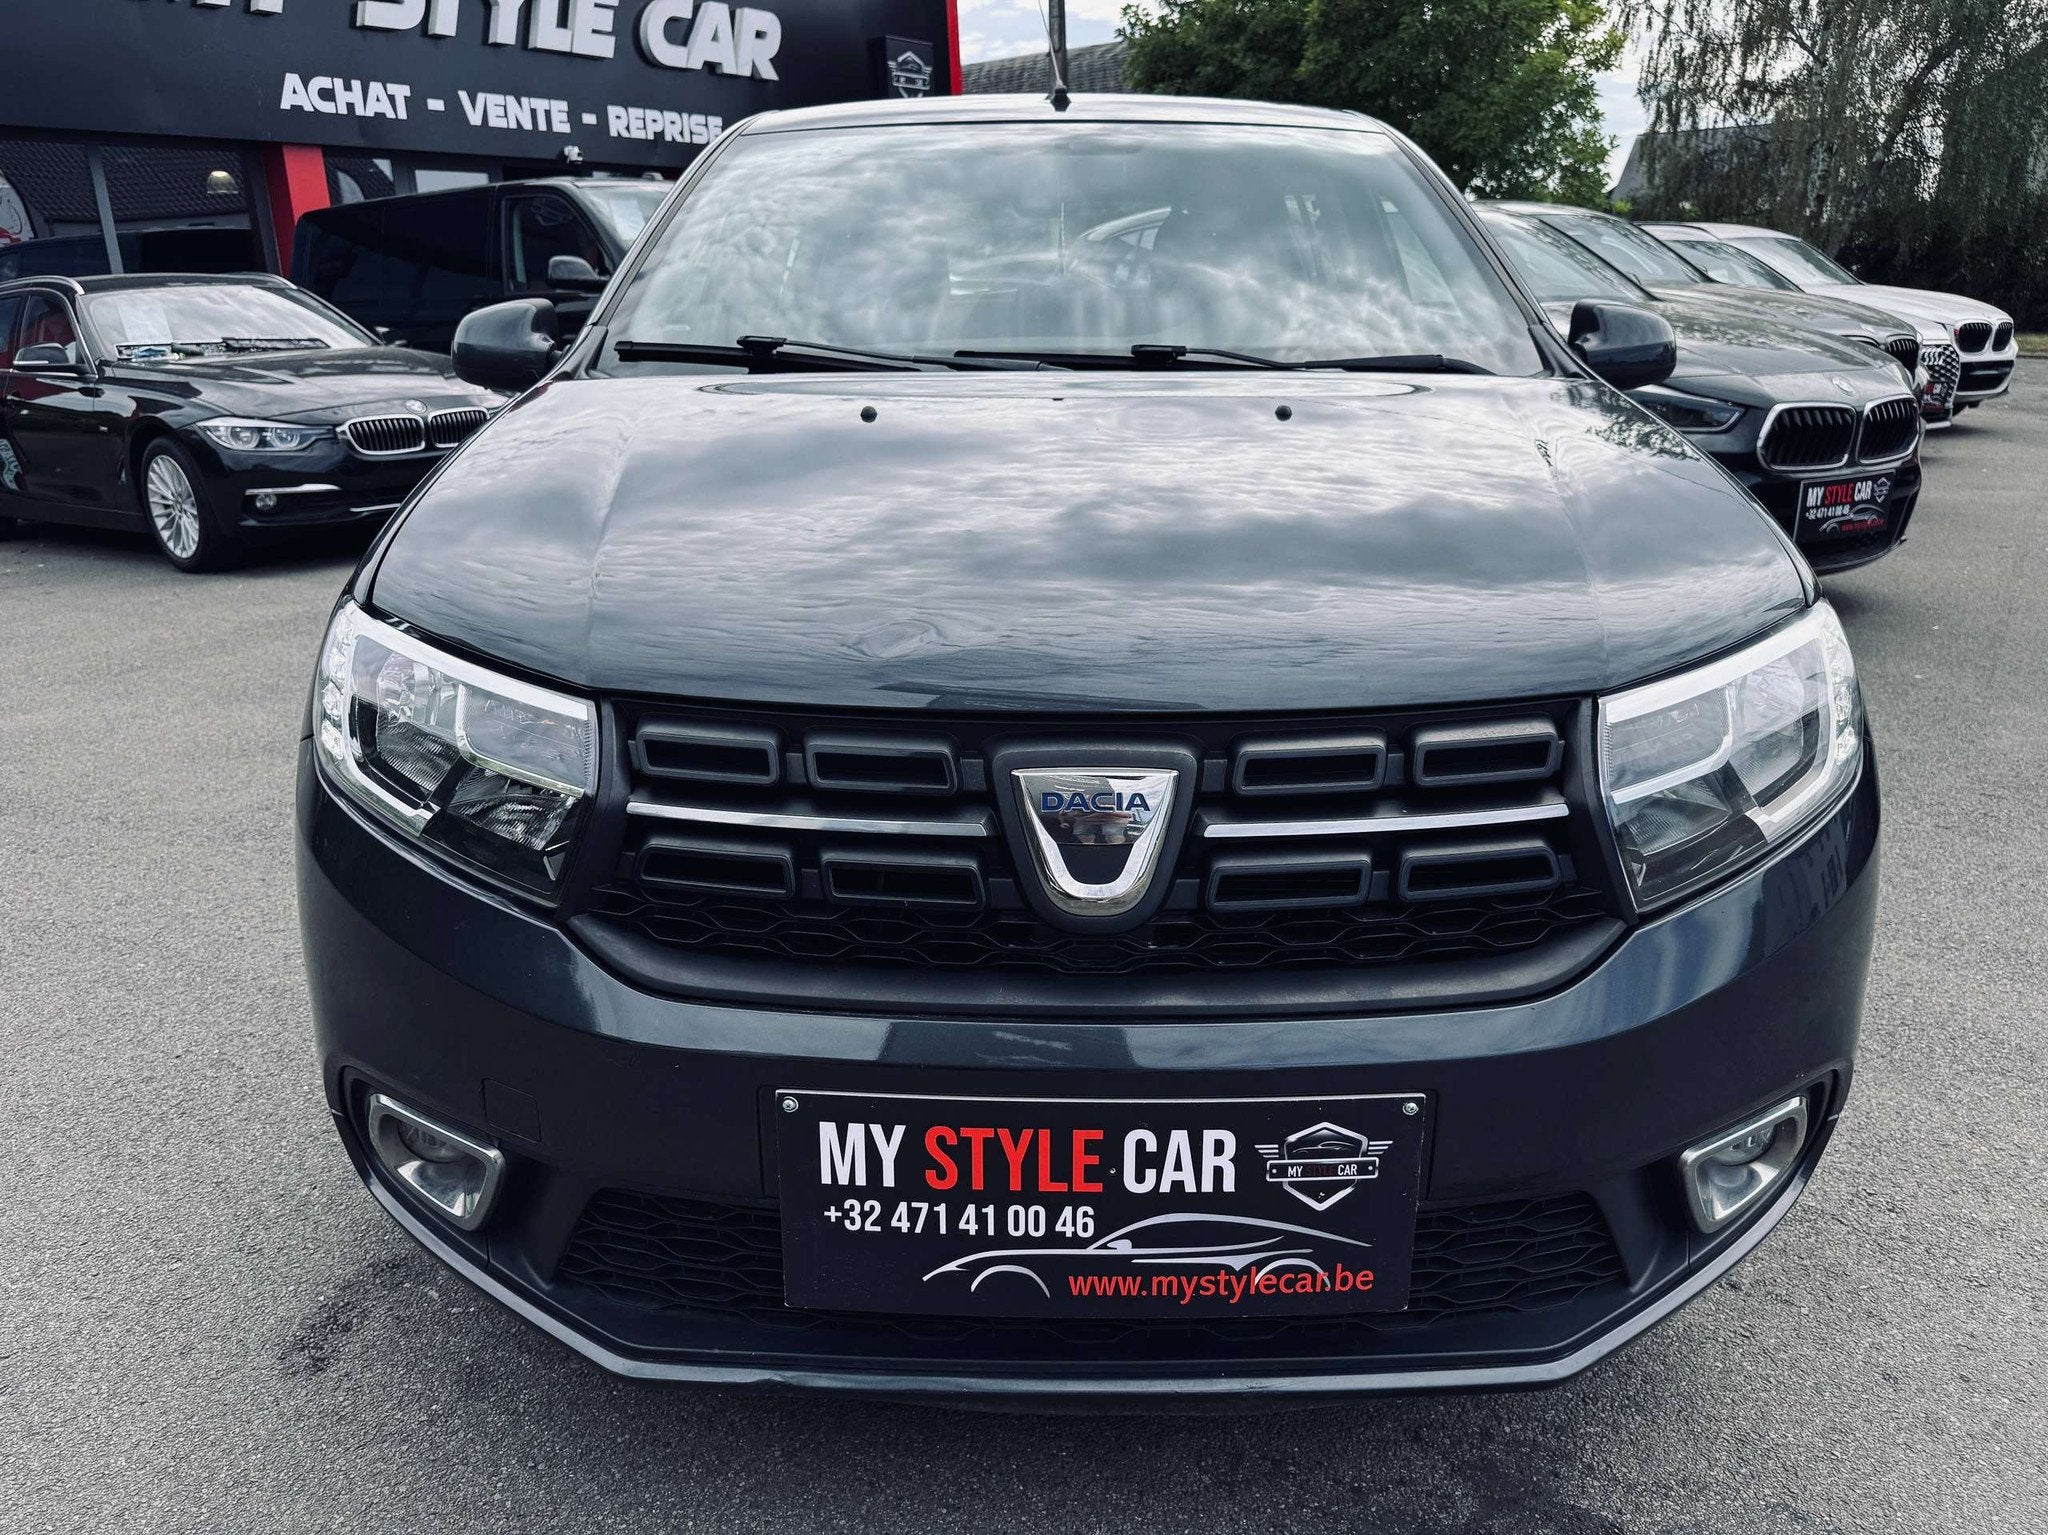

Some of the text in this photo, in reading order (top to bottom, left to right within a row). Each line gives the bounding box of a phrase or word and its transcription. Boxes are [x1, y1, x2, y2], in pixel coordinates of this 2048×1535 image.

[639, 0, 780, 81] CAR
[280, 73, 411, 120] ACHAT
[457, 90, 571, 133] VENTE
[607, 104, 723, 144] REPRISE
[1806, 481, 1872, 507] MY STYLE CAR
[1040, 792, 1150, 812] DACIA
[819, 1121, 1237, 1194] MY STYLE CAR
[1287, 1165, 1303, 1178] MY
[1337, 1164, 1358, 1176] CAR
[823, 1199, 1095, 1238] +32 471 41 00 46
[1068, 1263, 1375, 1305] www.mystylecar.be
